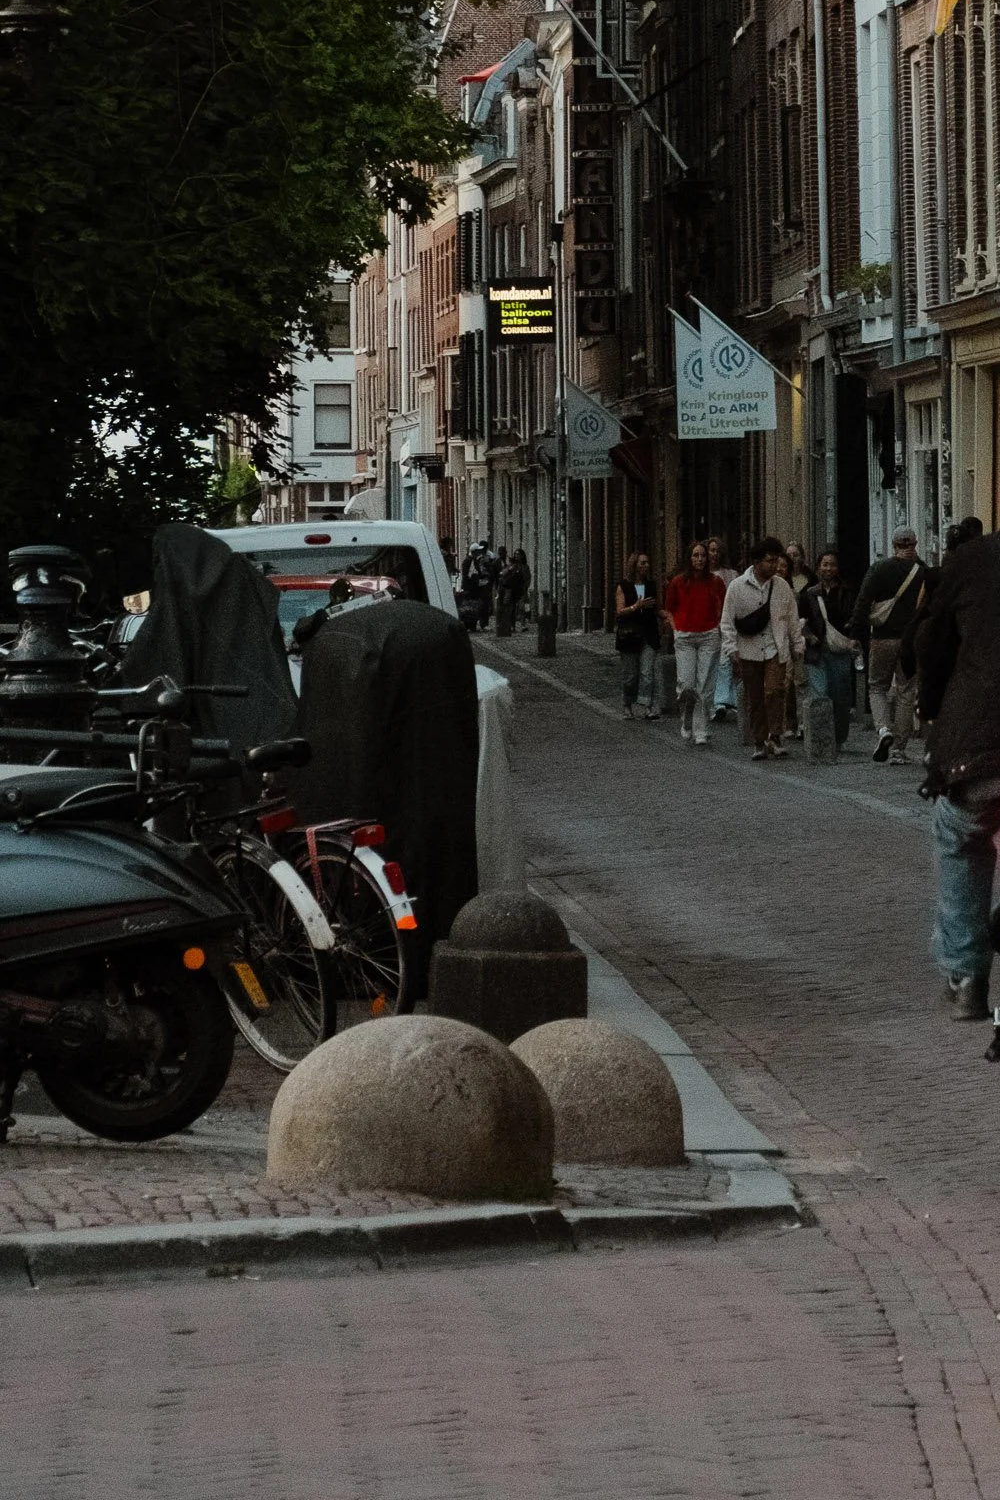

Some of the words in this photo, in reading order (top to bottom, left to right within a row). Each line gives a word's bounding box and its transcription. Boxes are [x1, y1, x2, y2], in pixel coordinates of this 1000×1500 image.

[489, 285, 552, 301] komdansen.nl
[501, 309, 553, 317] ballroom
[501, 317, 530, 325] salsa
[501, 326, 553, 334] CORNELISSEN
[708, 390, 769, 402] Kringloop
[681, 400, 706, 410] Krin
[709, 404, 726, 415] De
[729, 402, 759, 414] ARM
[681, 413, 697, 423] De
[709, 416, 761, 429] Utrecht
